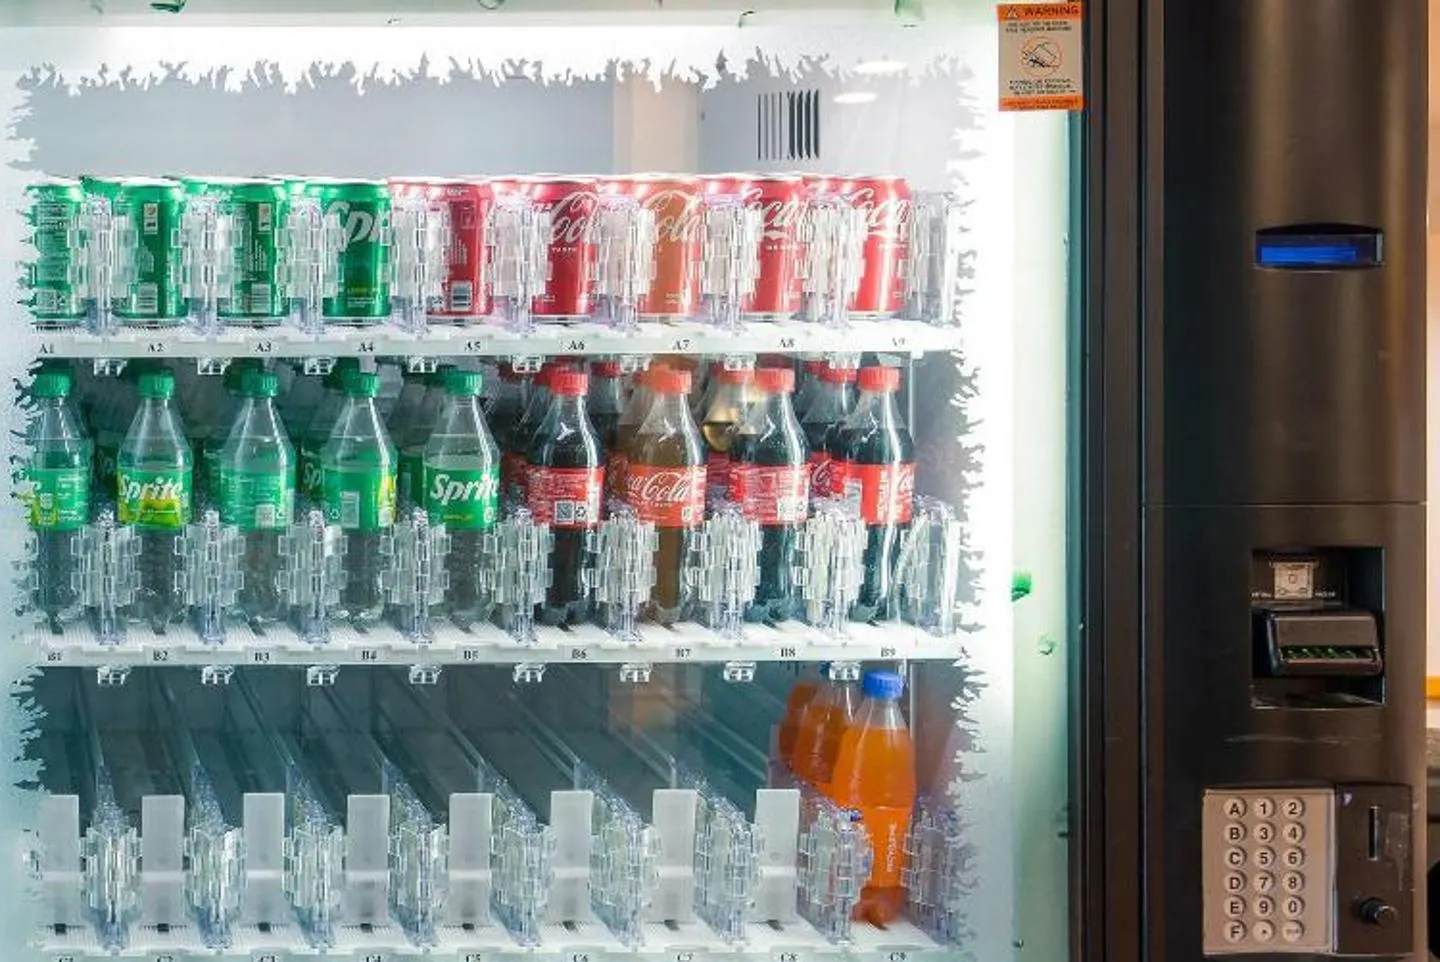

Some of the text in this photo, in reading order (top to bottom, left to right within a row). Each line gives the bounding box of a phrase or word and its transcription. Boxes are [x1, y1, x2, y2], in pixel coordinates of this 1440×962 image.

[39, 344, 55, 354] A1
[148, 343, 164, 353] A2
[255, 342, 271, 353] A3
[358, 342, 374, 352] A4
[568, 340, 584, 351] A6
[672, 339, 690, 350] A7
[1229, 803, 1241, 815] A
[1260, 802, 1267, 815] 1
[1288, 802, 1297, 815] 2
[1229, 827, 1240, 840] B
[1260, 827, 1268, 840] 3
[1287, 827, 1297, 840] 4
[1229, 852, 1241, 865] C
[1260, 852, 1268, 865] 5
[1288, 852, 1297, 865] 6
[1229, 877, 1241, 889] D
[1259, 877, 1268, 889] 7
[1288, 877, 1297, 889] 8
[1230, 901, 1240, 914] E
[1260, 901, 1268, 914] 9
[1288, 901, 1297, 914] 0
[1230, 925, 1240, 938] F
[573, 953, 588, 962] C6
